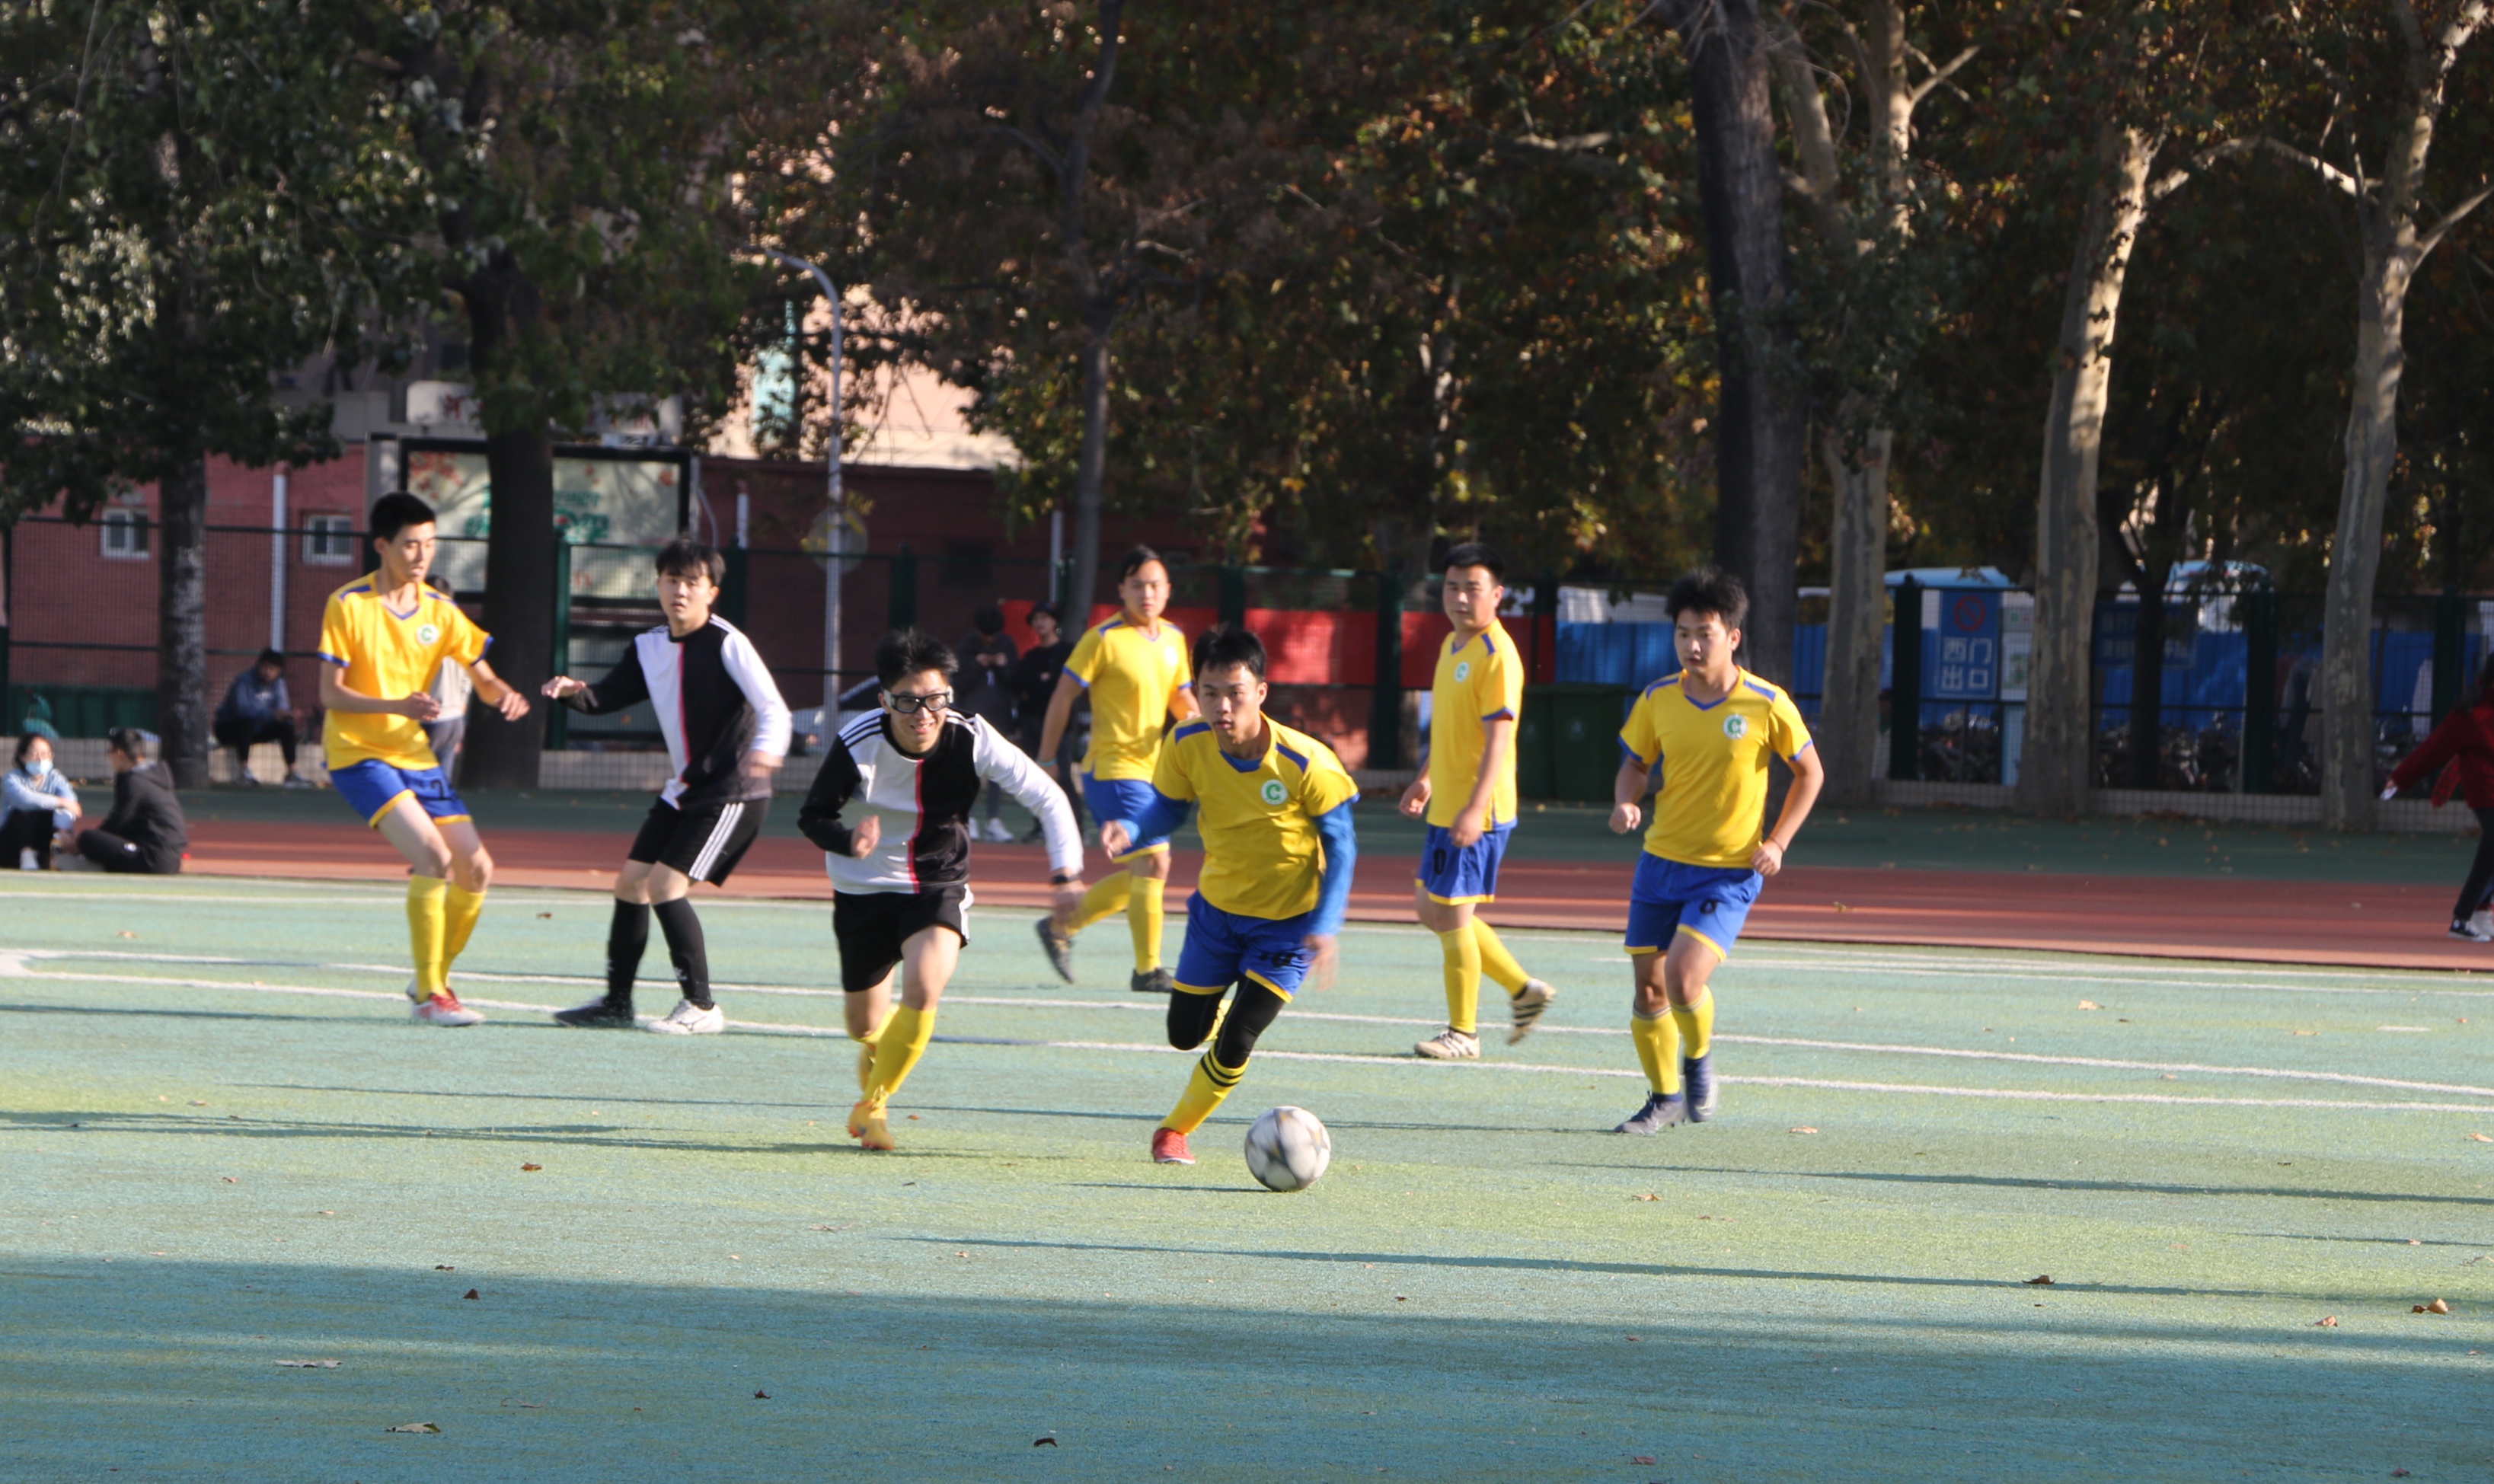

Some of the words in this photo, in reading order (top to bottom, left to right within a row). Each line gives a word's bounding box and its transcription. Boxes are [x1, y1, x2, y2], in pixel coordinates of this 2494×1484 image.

[420, 627, 433, 643] C
[1943, 637, 1993, 665] 西门
[1456, 665, 1467, 679] C
[1941, 664, 1989, 691] 出口
[1727, 718, 1742, 734] C
[1265, 783, 1282, 801] C
